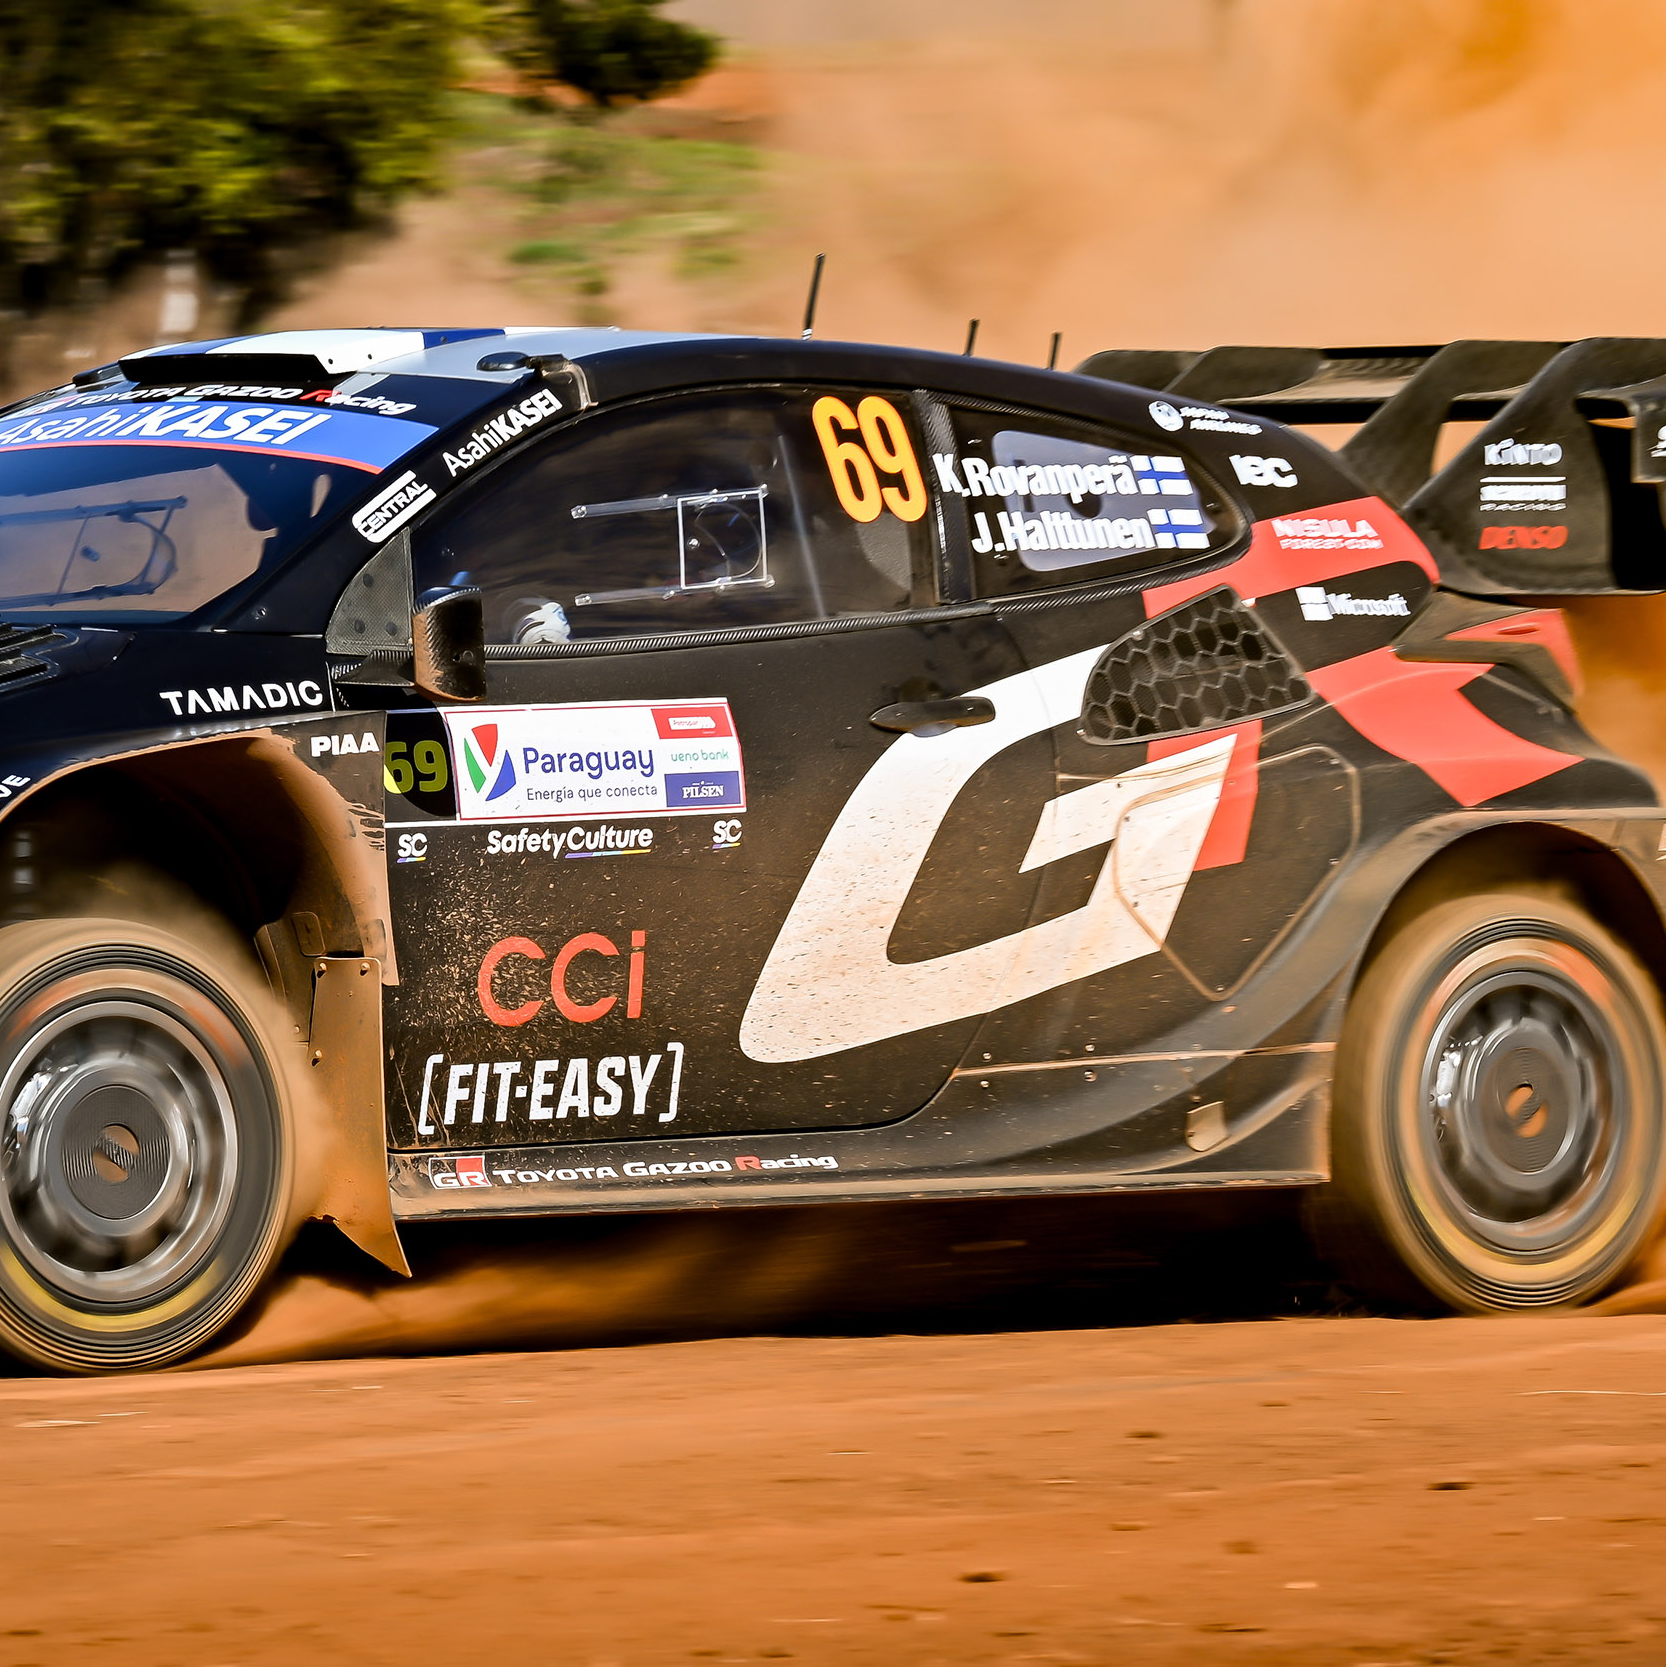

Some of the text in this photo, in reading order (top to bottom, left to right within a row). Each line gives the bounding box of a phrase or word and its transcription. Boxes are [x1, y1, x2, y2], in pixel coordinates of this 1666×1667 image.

[71, 386, 182, 407] TOYOTA
[190, 383, 302, 400] GAZOO
[299, 389, 417, 415] Racing
[442, 389, 563, 477] AsahiKASEI
[812, 395, 928, 522] 69
[358, 478, 428, 538] CENTRAL
[1478, 525, 1569, 550] DENSO
[159, 680, 324, 716] TAMADIC
[310, 732, 380, 757] PIAA
[671, 749, 729, 762] ueno bank
[383, 740, 448, 794] 69
[523, 747, 654, 780] Paraguay
[526, 784, 658, 803] Energía que conecta
[682, 785, 724, 799] PILSEN
[397, 833, 428, 858] SC
[486, 825, 654, 859] SafetyCulture
[712, 820, 743, 846] SC
[434, 1153, 840, 1188] GR TOYOTA GAZOO Racing
